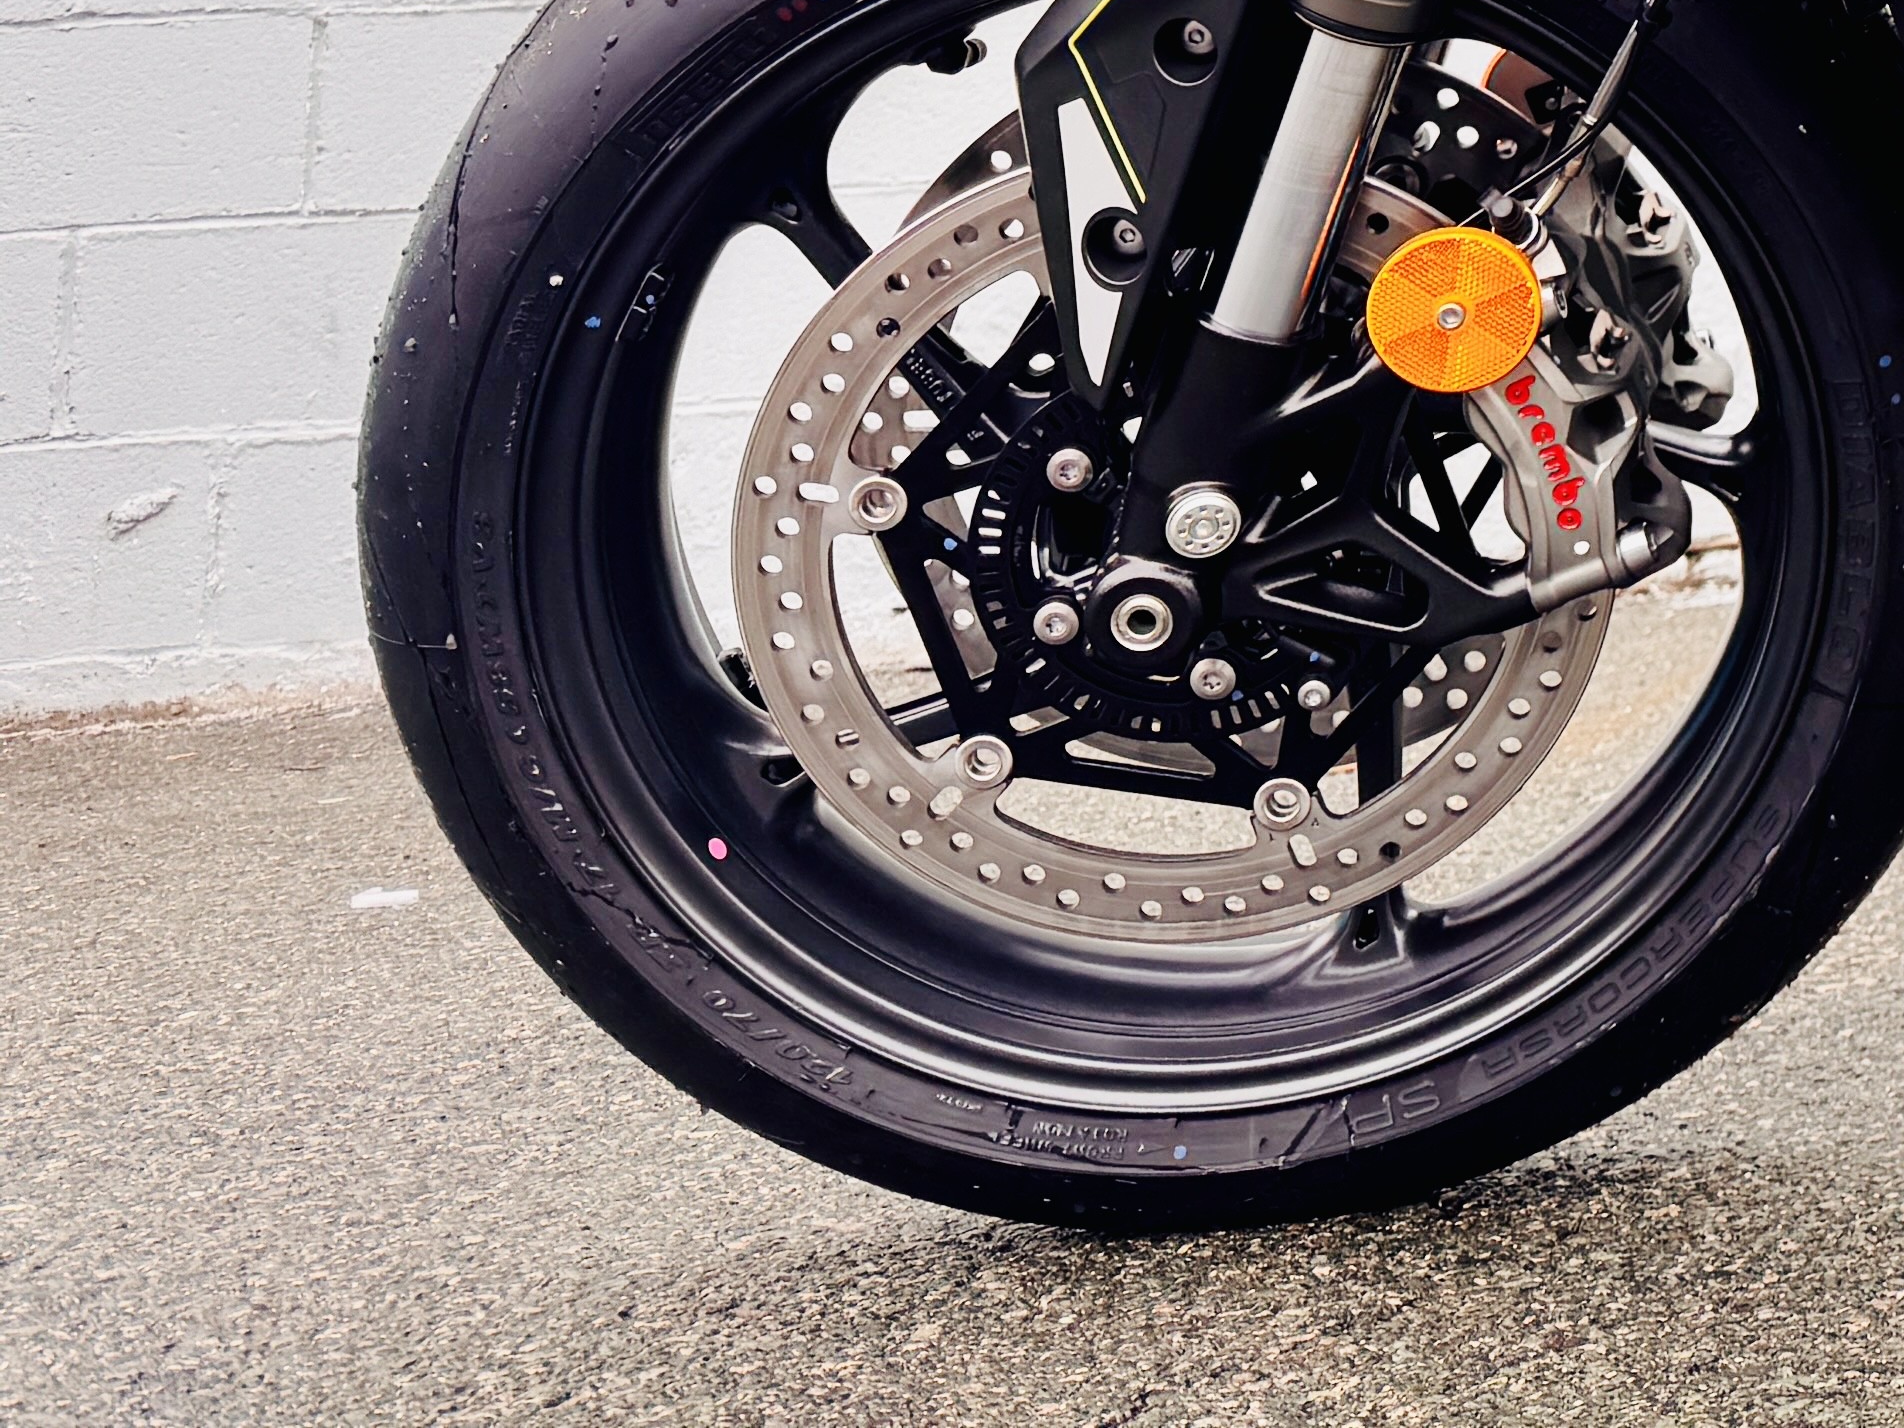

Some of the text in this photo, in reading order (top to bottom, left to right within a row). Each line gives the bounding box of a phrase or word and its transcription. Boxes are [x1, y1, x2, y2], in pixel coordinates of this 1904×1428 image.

[1504, 374, 1585, 531] brembo
[1828, 392, 1876, 662] DIABLO
[1342, 804, 1788, 1132] SUPERCORSA SP
